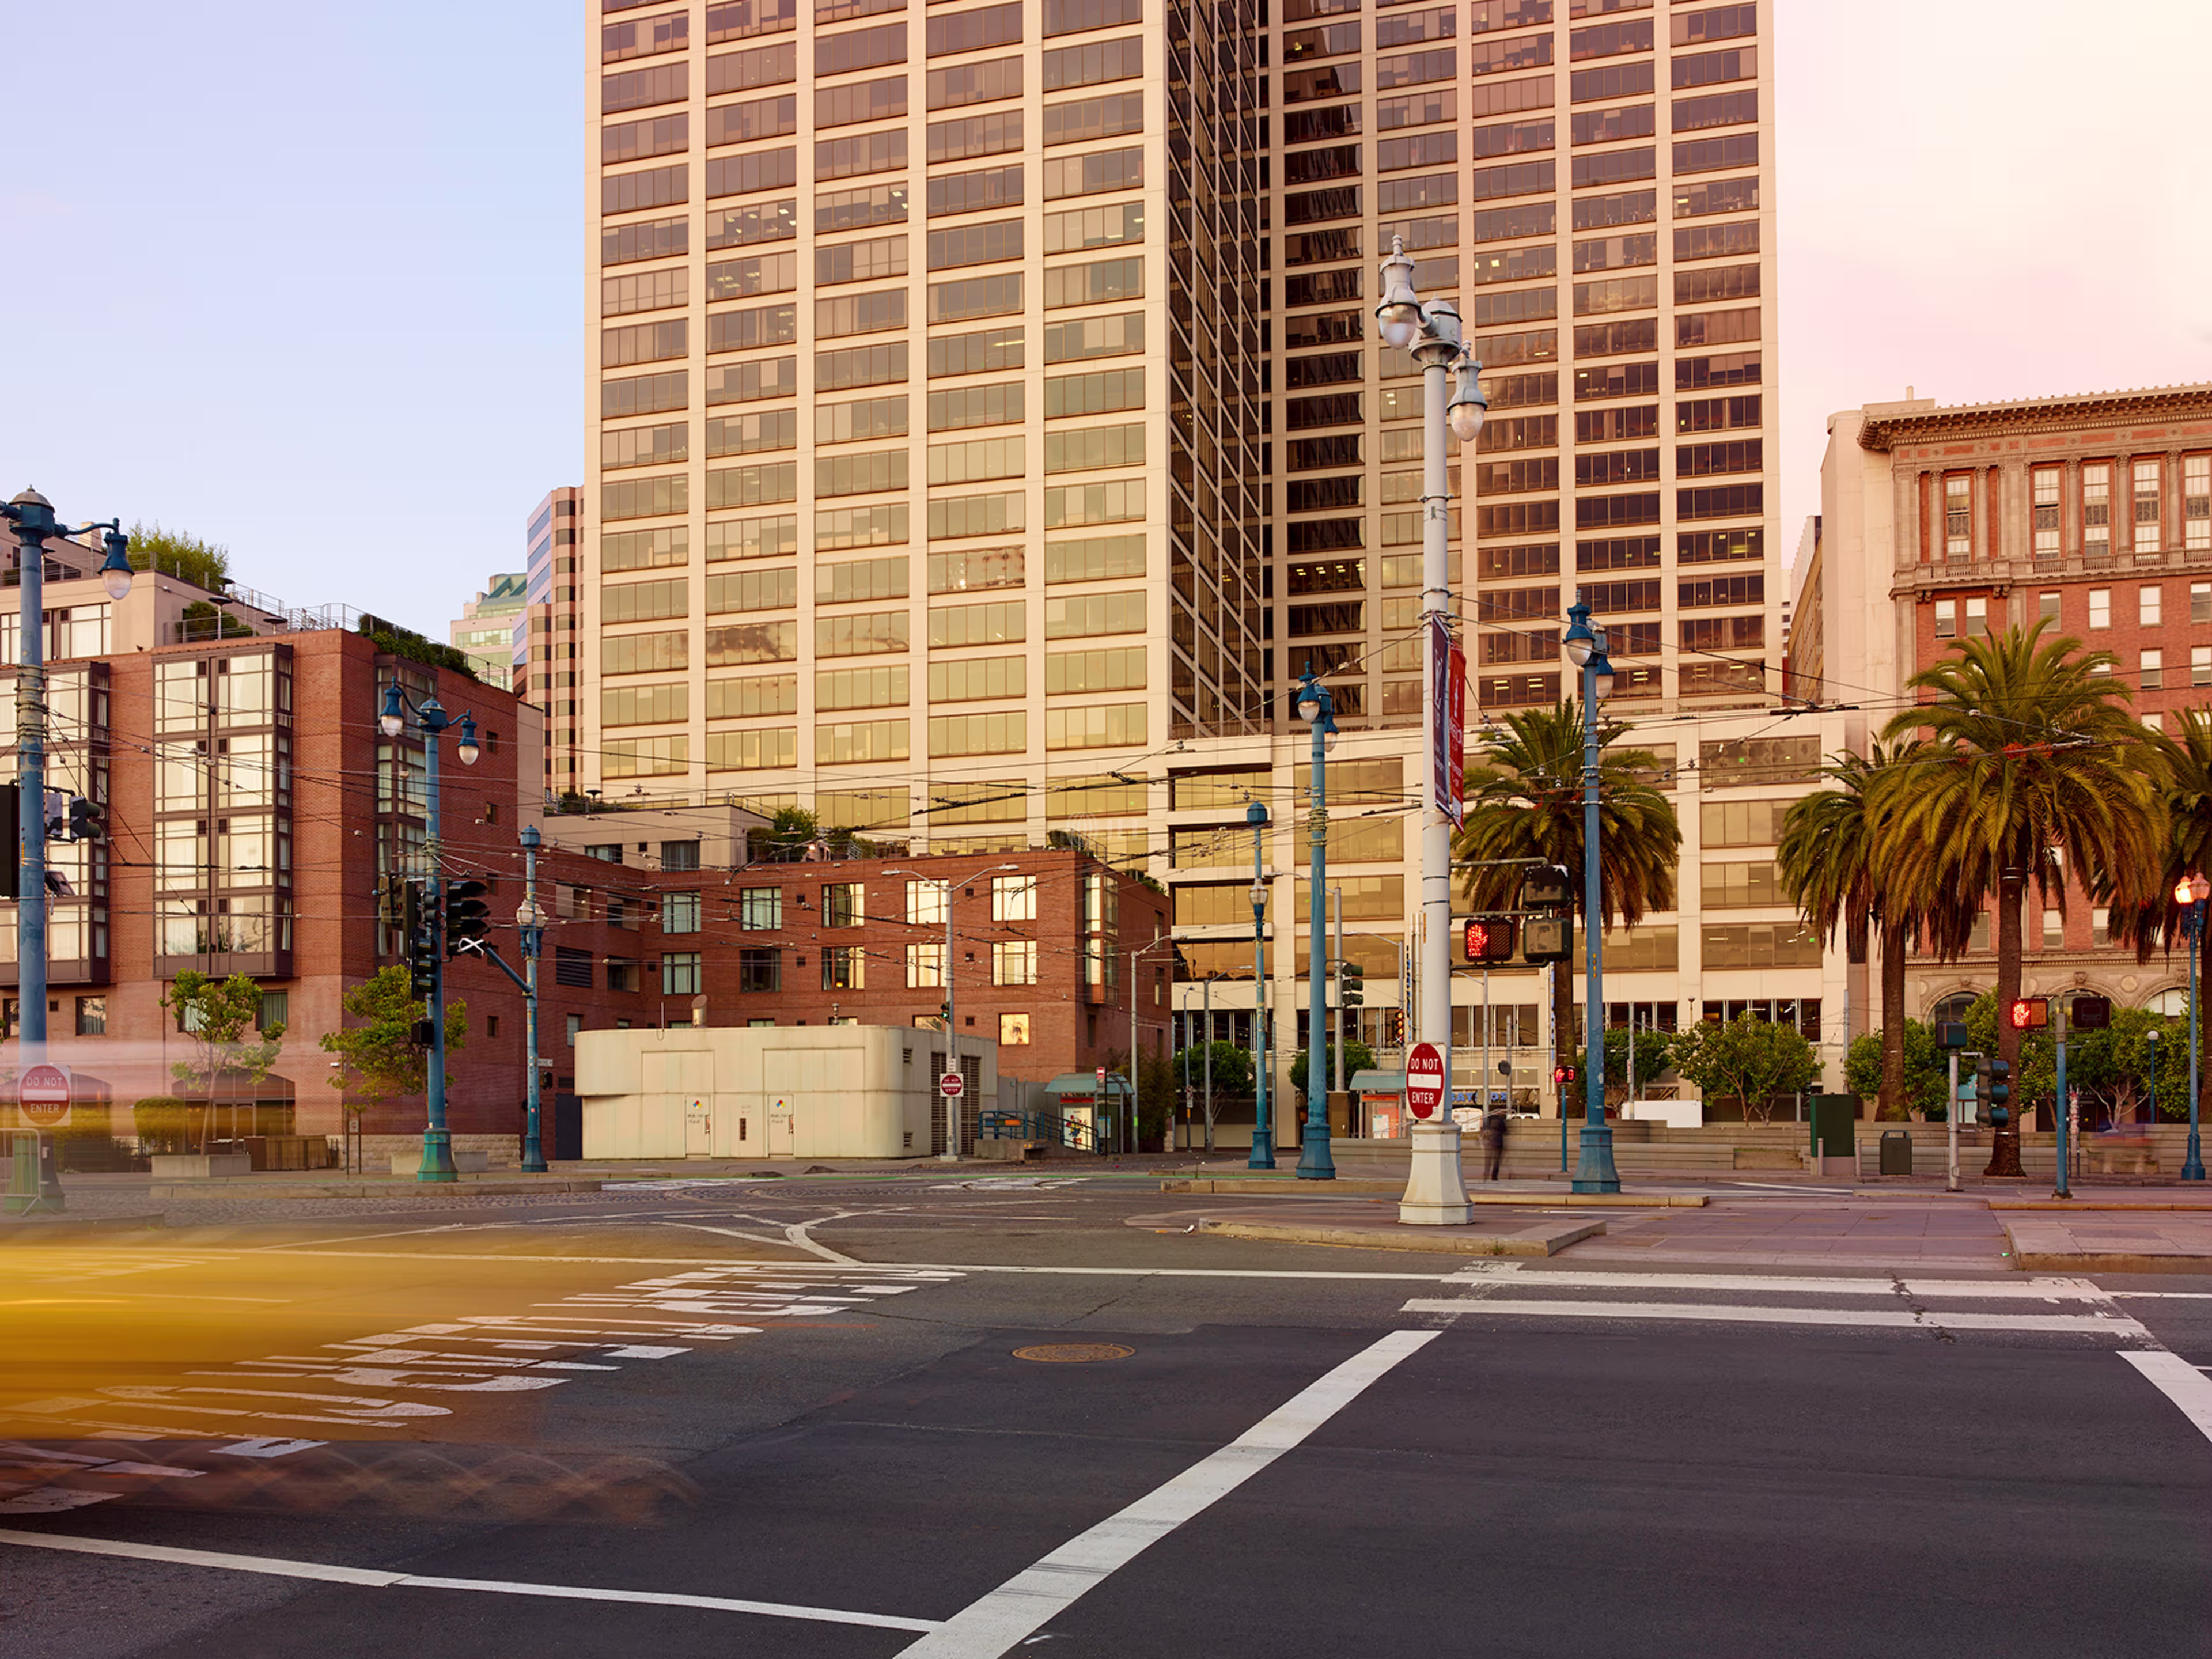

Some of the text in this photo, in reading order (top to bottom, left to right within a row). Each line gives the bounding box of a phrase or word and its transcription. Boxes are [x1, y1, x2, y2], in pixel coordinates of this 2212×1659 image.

[1411, 1058, 1438, 1070] DO NOT
[26, 1076, 62, 1087] DO NOT
[1412, 1091, 1434, 1104] ENTER
[31, 1104, 60, 1113] ENTER
[529, 1266, 968, 1316] CLEAR
[182, 1315, 764, 1392] CLEAR
[0, 1384, 453, 1514] CLE
